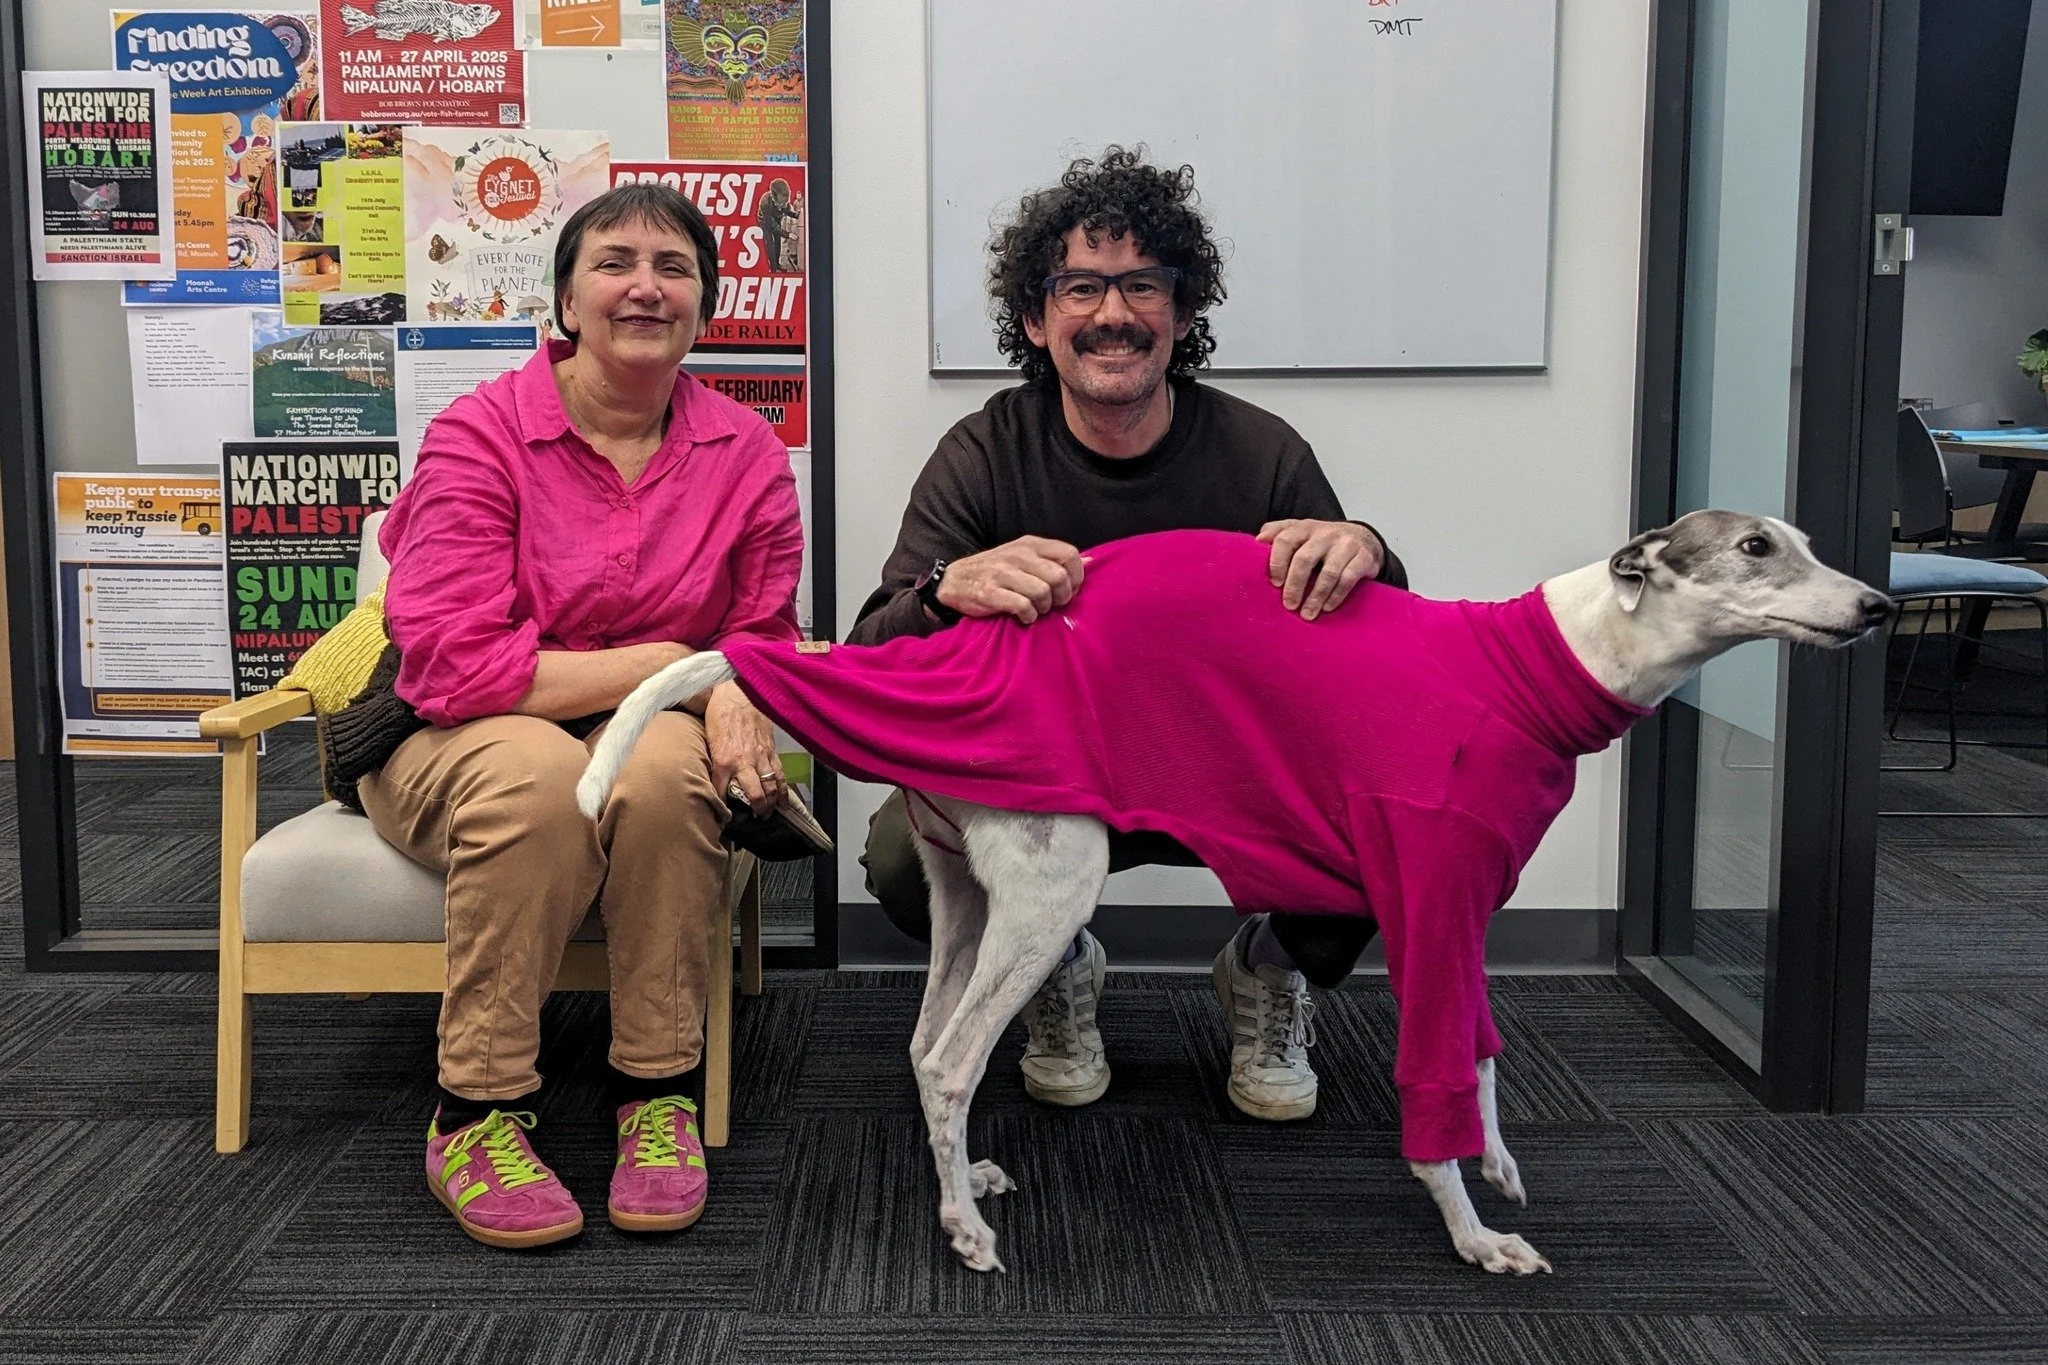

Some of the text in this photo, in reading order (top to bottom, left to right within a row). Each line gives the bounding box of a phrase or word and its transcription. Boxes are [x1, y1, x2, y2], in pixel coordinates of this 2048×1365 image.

[1368, 18, 1423, 36] DMT
[127, 24, 252, 57] Finding
[338, 50, 508, 63] 11 AM 27 APRIL 2025
[341, 65, 506, 78] PARLIAMENT LAWNS
[180, 87, 272, 98] Week Art Exhibition
[343, 80, 506, 94] NIPALUNA / HOBART
[43, 92, 150, 107] NATIONWIDE
[43, 107, 150, 122] MARCH FOR
[740, 107, 758, 115] ART
[762, 106, 803, 115] AUCTION
[674, 116, 715, 124] GALLERY
[723, 116, 760, 124] RAFFLE
[44, 122, 151, 138] PALESTINE
[197, 129, 207, 137] to
[45, 149, 151, 167] HOBART
[190, 148, 203, 156] for
[193, 158, 215, 166] 2025
[484, 179, 535, 194] CYGNET
[500, 190, 537, 204] Festival
[113, 221, 154, 230] 24 AUG
[184, 220, 215, 228] 5.45pm
[61, 254, 146, 262] SANCTION ISRAEL
[476, 251, 544, 267] EVERY NOTE
[494, 265, 526, 275] FOR THE
[481, 276, 539, 293] PLANET
[738, 325, 797, 340] RALLY
[272, 348, 385, 366] Kunanyi Reflections
[714, 379, 805, 403] FEBRUARY
[304, 415, 332, 424] Thursday
[230, 454, 398, 480] NATIONWID
[85, 483, 221, 499] Keep our transpo
[231, 479, 398, 505] MARCH FO
[85, 497, 153, 509] public to
[85, 510, 177, 524] keep Tassie
[232, 505, 384, 535] PALEST
[86, 523, 145, 538] moving
[236, 566, 357, 602] SUND
[239, 604, 281, 630] 24
[235, 633, 319, 648] NIPALUN
[238, 652, 285, 662] Meet at
[239, 666, 269, 679] TAC)
[271, 668, 285, 676] at
[240, 681, 269, 692] 11am
